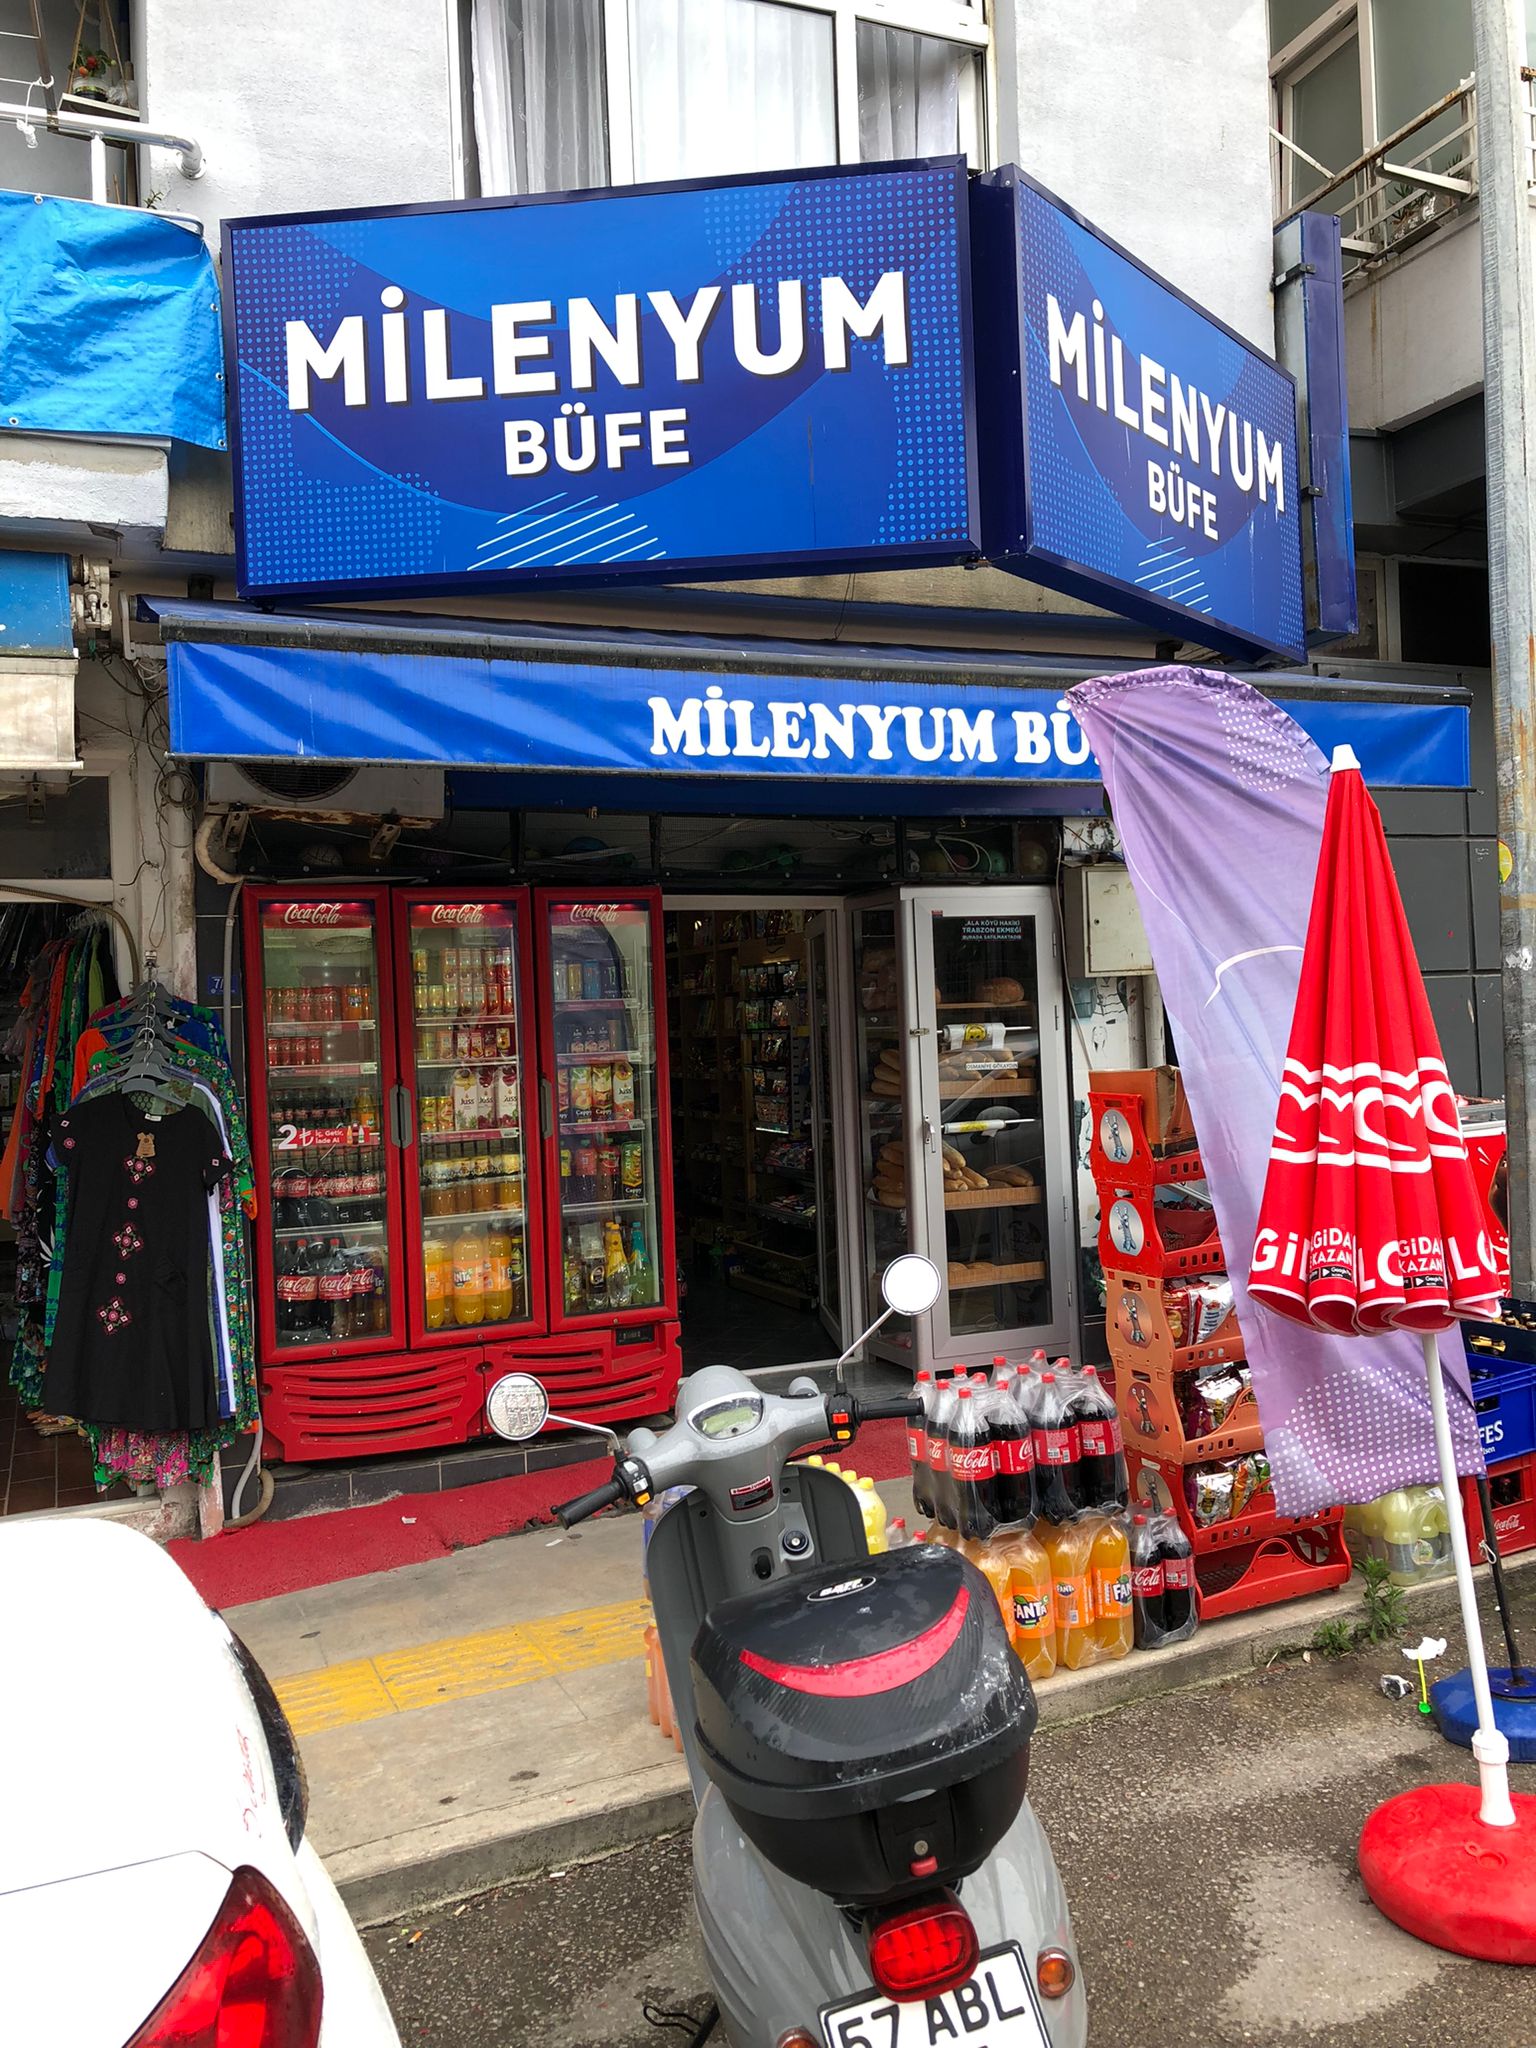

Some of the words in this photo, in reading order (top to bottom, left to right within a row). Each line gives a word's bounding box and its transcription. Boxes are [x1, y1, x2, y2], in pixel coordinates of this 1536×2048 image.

[285, 271, 908, 410] MİLENYUM
[504, 402, 690, 475] BÜFE
[1046, 293, 1285, 512] MİLENYUM
[1147, 460, 1219, 541] BÜFE
[648, 685, 998, 764] MİLENYUM
[1011, 700, 1099, 765] BÜ
[284, 903, 342, 925] Coca-Cola
[431, 904, 485, 924] Coca-Cola
[570, 904, 619, 923] Coca-Cola
[925, 1971, 1025, 2046] ABL
